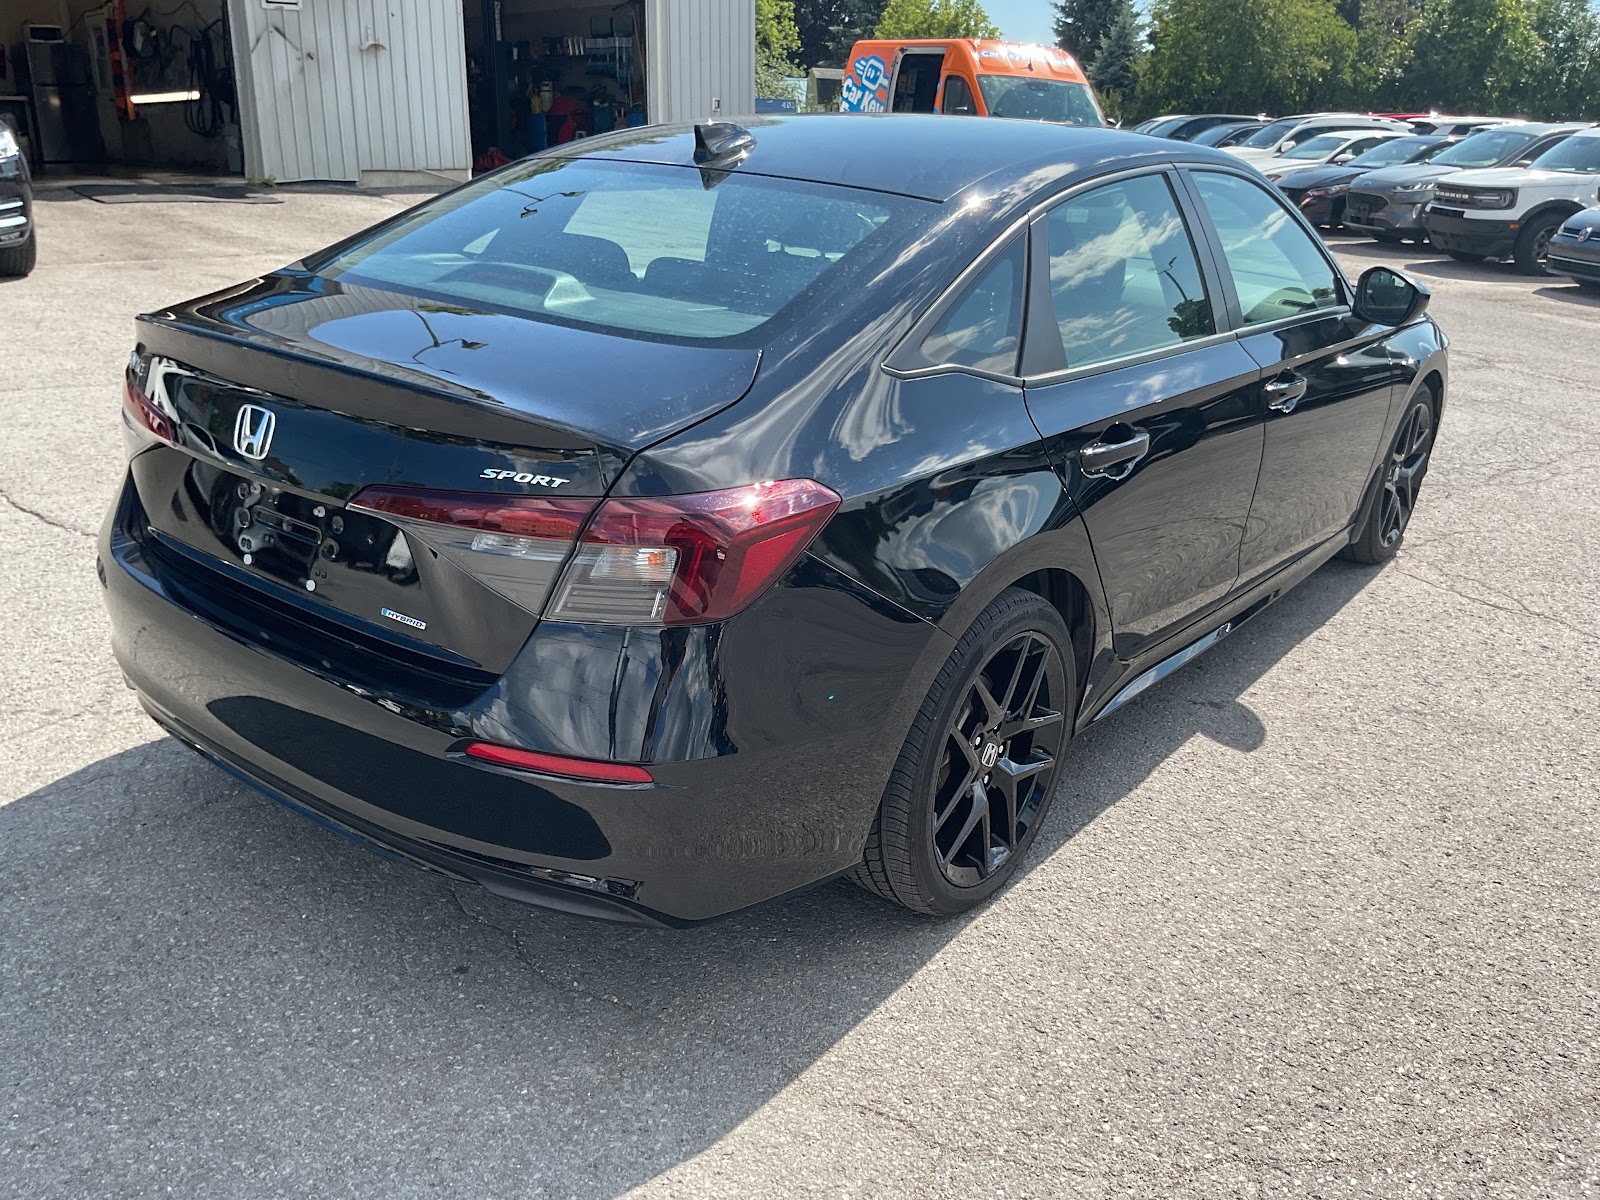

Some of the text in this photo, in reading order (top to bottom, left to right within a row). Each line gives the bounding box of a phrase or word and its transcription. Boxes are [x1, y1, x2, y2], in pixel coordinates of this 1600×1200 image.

[842, 78, 863, 105] Car
[480, 468, 570, 488] SPORT
[387, 611, 424, 628] HYBRID
